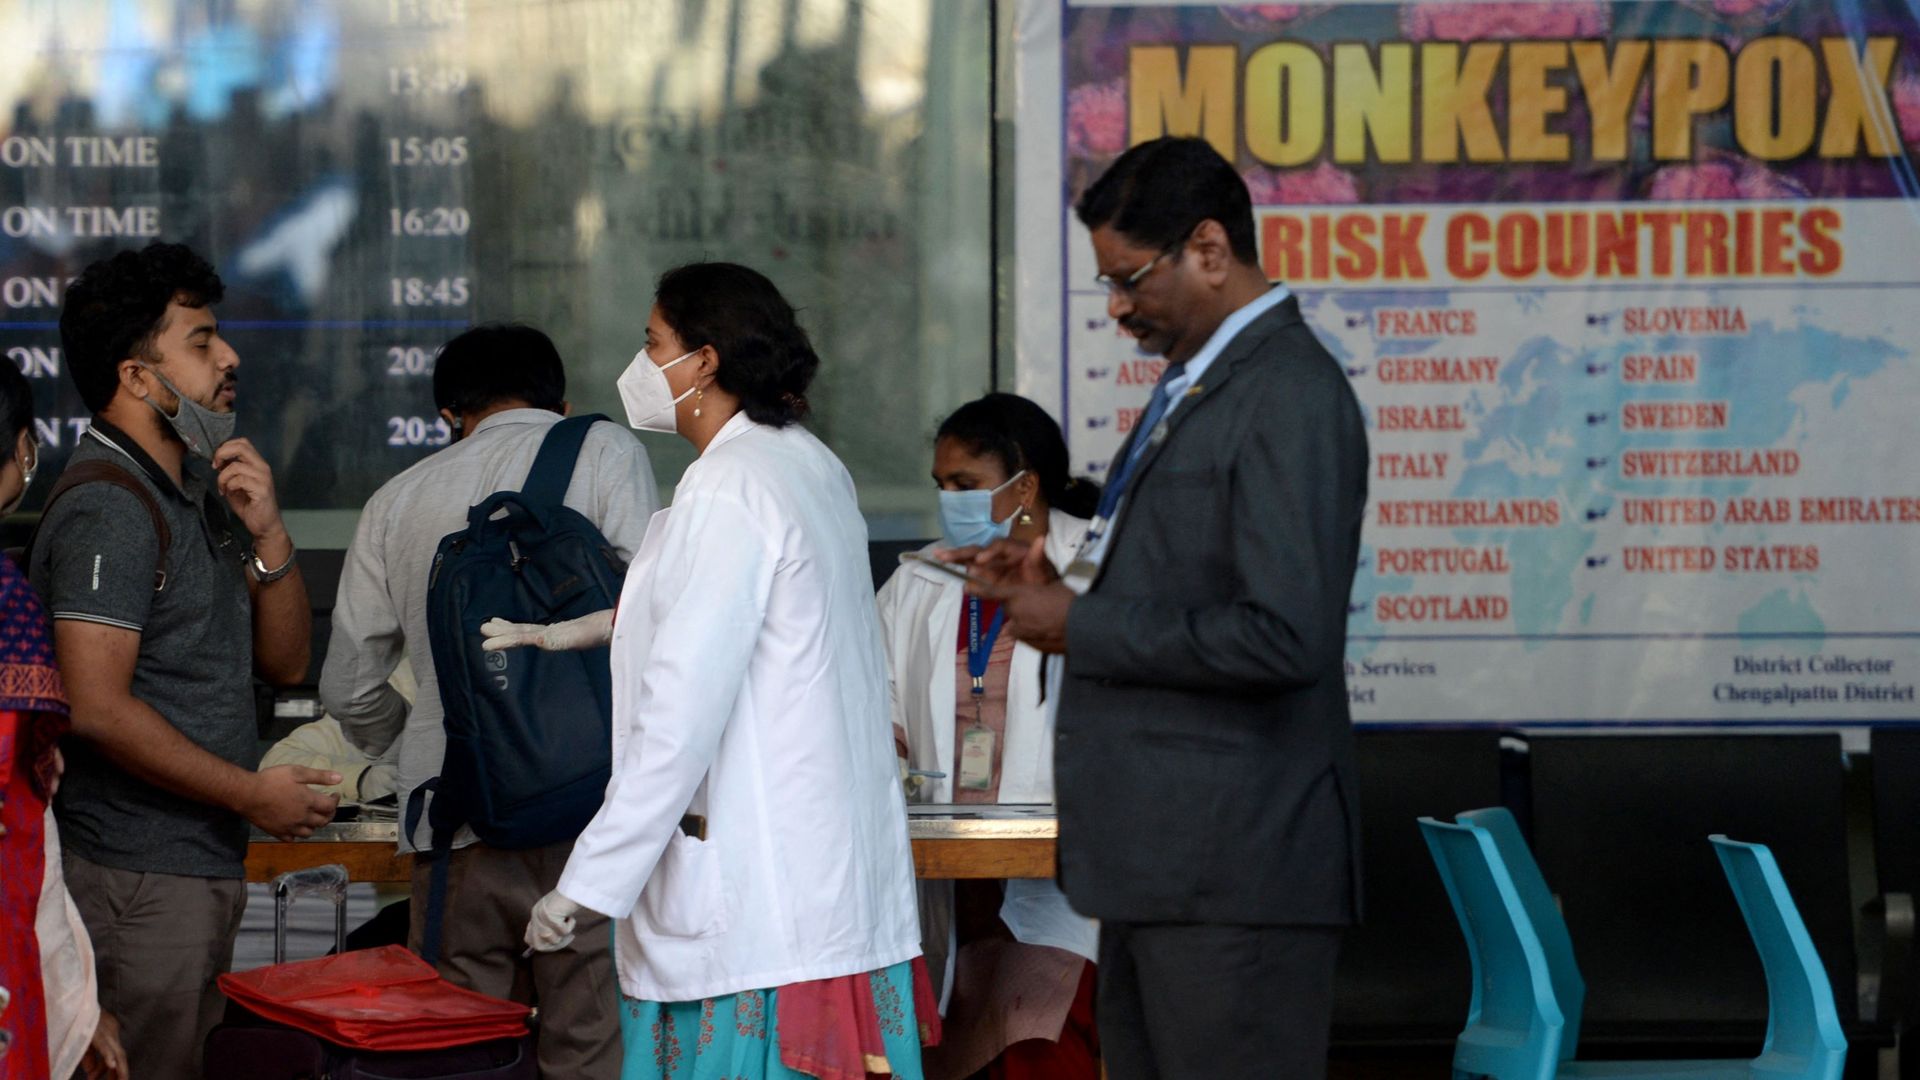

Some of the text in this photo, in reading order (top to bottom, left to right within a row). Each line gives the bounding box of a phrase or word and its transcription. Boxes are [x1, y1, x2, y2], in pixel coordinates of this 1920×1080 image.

[1129, 37, 1901, 166] MONKEYPOX
[1, 136, 159, 167] ON TIME
[389, 136, 468, 166] 15:05
[3, 207, 160, 237] ON TIME
[390, 207, 470, 236] 16:20
[1261, 208, 1843, 282] RISK COUNTRIES
[3, 276, 59, 308] ON
[390, 277, 469, 306] 18:45
[1377, 309, 1477, 336] FRANCE
[1623, 306, 1747, 334] SLOVENIA
[387, 346, 437, 376] 20:
[1116, 359, 1164, 385] AUS
[1377, 357, 1498, 384] GERMANY
[1622, 354, 1696, 381] SPAIN
[1377, 405, 1466, 432] ISRAEL
[1622, 402, 1728, 429] SWEDEN
[387, 417, 453, 446] 20:5
[1377, 452, 1449, 480] ITALY
[1622, 449, 1801, 476] SWITZERLAND
[1377, 500, 1561, 527] NETHERLANDS
[1622, 497, 1920, 525] UNITED ARAB EMIRATES
[1377, 548, 1509, 575] PORTUGAL
[1622, 545, 1820, 573] UNITED STATES
[1377, 595, 1509, 622] SCOTLAND
[1361, 657, 1437, 677] Services
[1733, 655, 1895, 675] District Collector
[1712, 682, 1915, 706] Chengalpattu District
